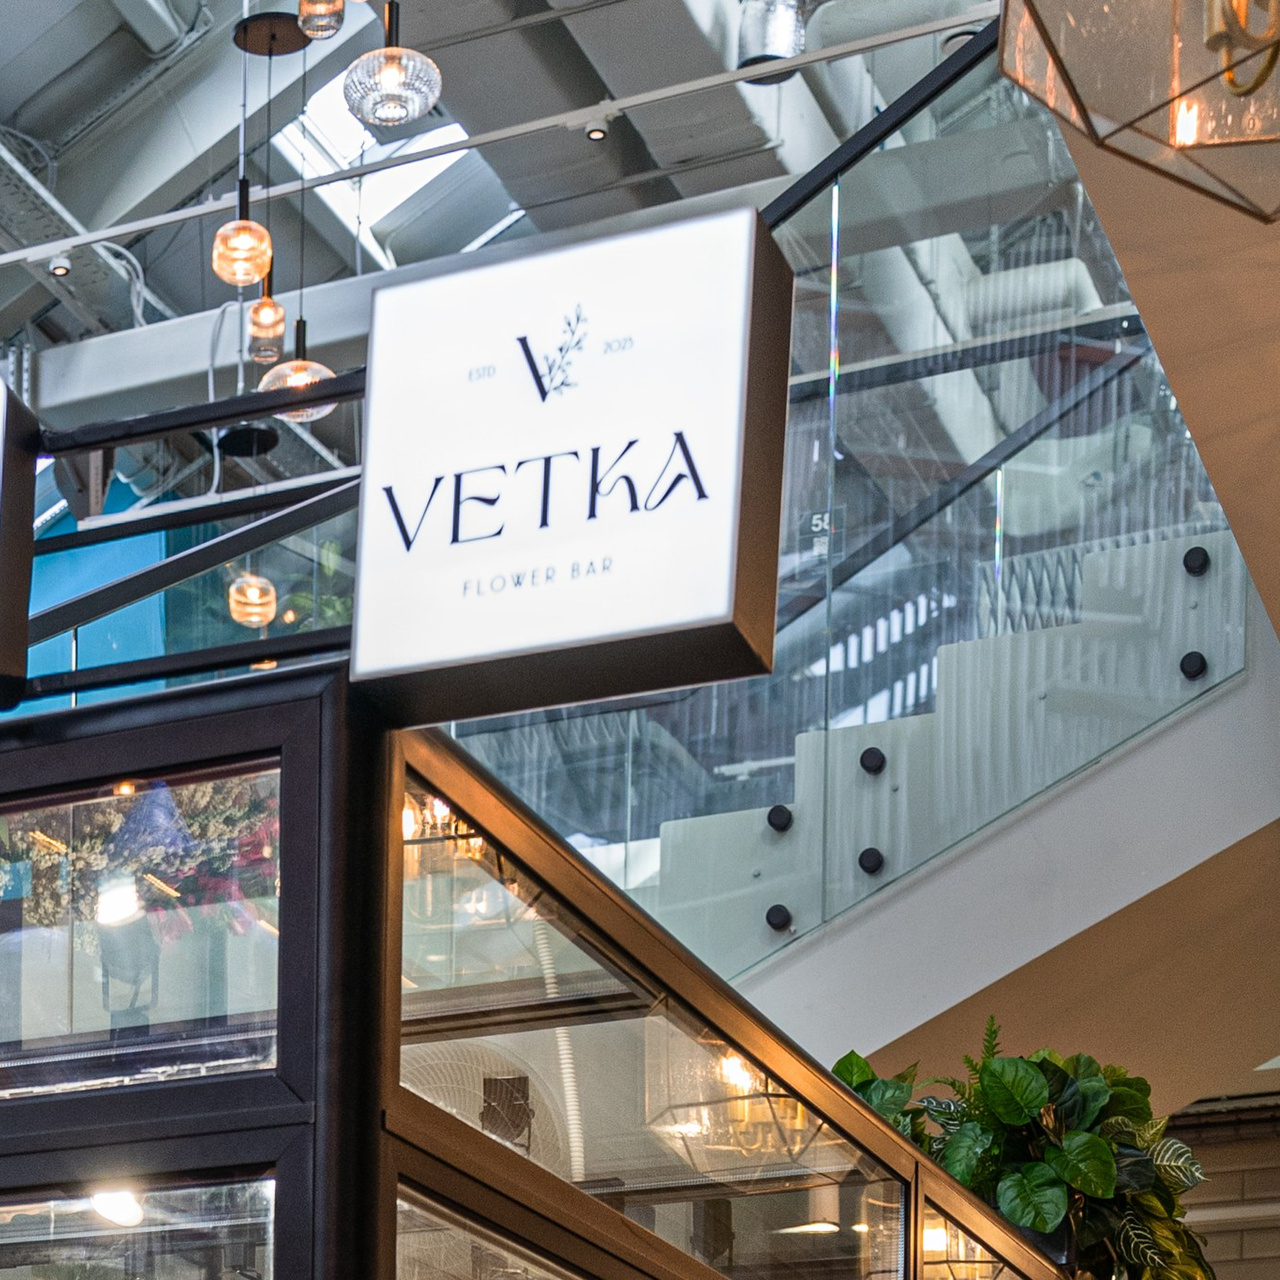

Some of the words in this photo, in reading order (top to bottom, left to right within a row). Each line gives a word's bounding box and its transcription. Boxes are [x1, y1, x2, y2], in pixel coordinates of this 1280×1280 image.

[382, 431, 709, 552] VETKA
[462, 566, 556, 598] FLOWER
[571, 556, 614, 580] BAR
